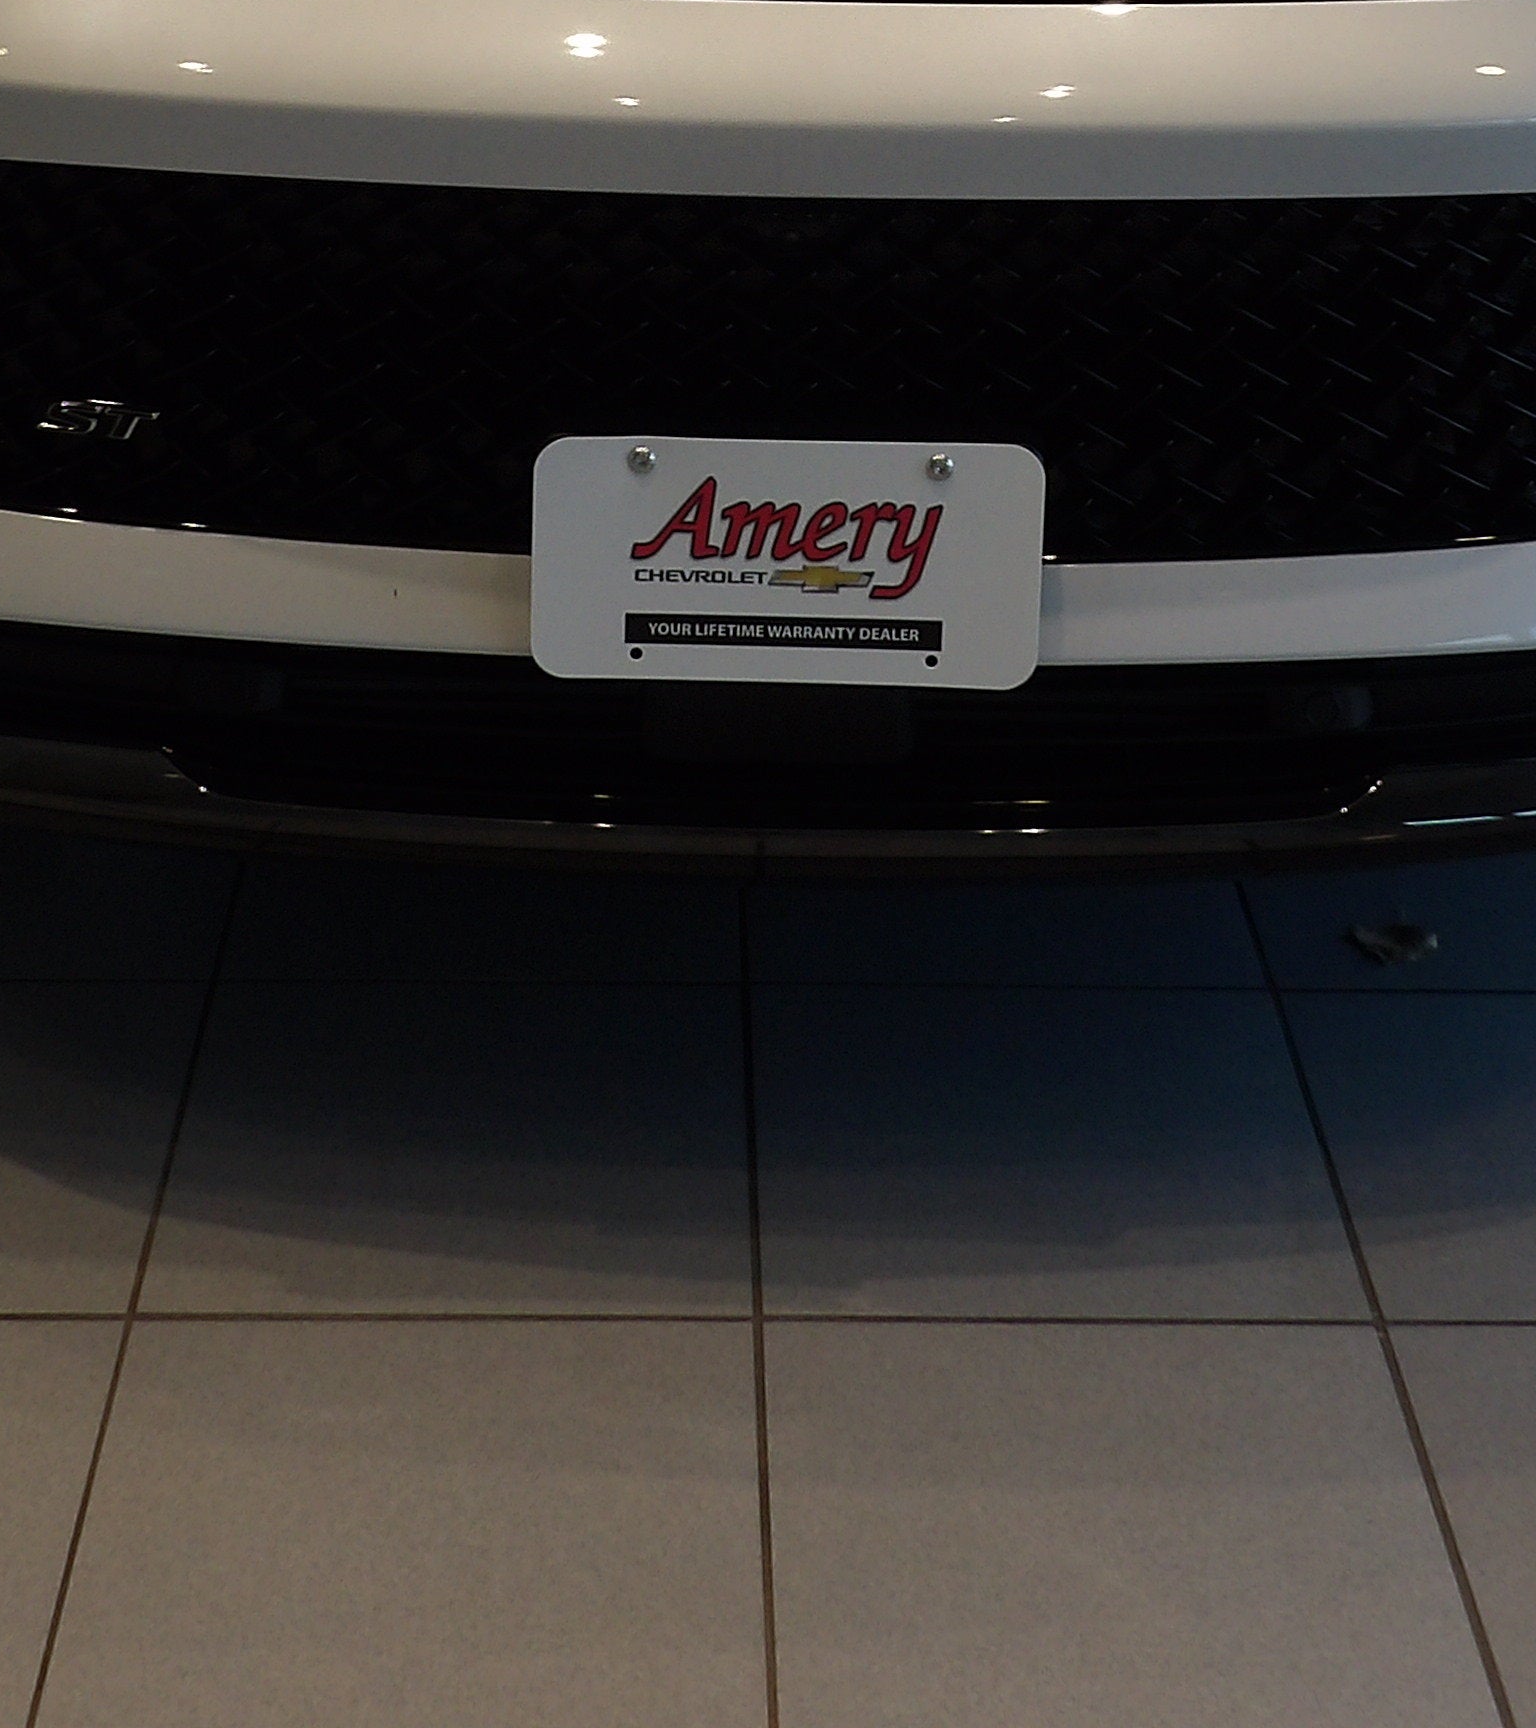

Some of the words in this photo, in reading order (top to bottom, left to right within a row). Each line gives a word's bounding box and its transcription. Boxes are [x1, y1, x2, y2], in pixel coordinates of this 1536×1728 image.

[37, 399, 161, 440] ST
[630, 476, 943, 599] Amery
[634, 568, 768, 585] CHEVROLET
[648, 622, 692, 637] YOUR
[695, 623, 764, 638] LIFETIME
[767, 624, 856, 640] WARRANTY
[859, 627, 920, 642] DEALER
